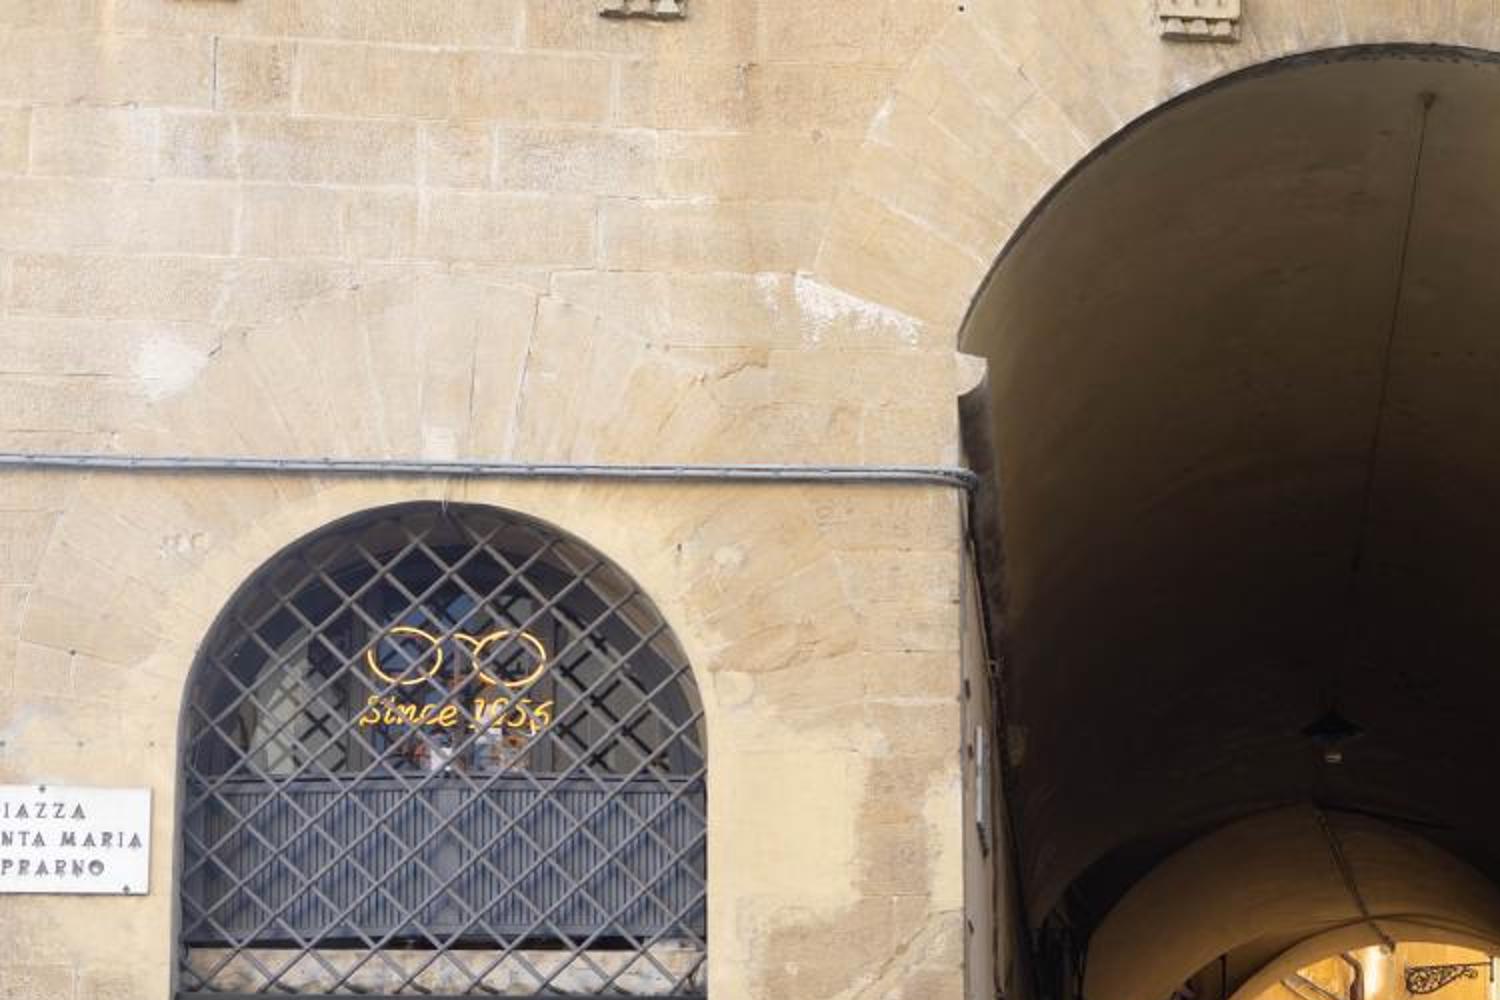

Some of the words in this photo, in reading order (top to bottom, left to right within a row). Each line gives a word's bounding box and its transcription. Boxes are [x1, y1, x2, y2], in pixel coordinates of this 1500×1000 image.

[359, 695, 457, 727] Since
[2, 802, 86, 819] IAZZA
[1, 831, 46, 847] NTA
[60, 831, 143, 848] MARIA
[1, 859, 105, 876] PRARNO
